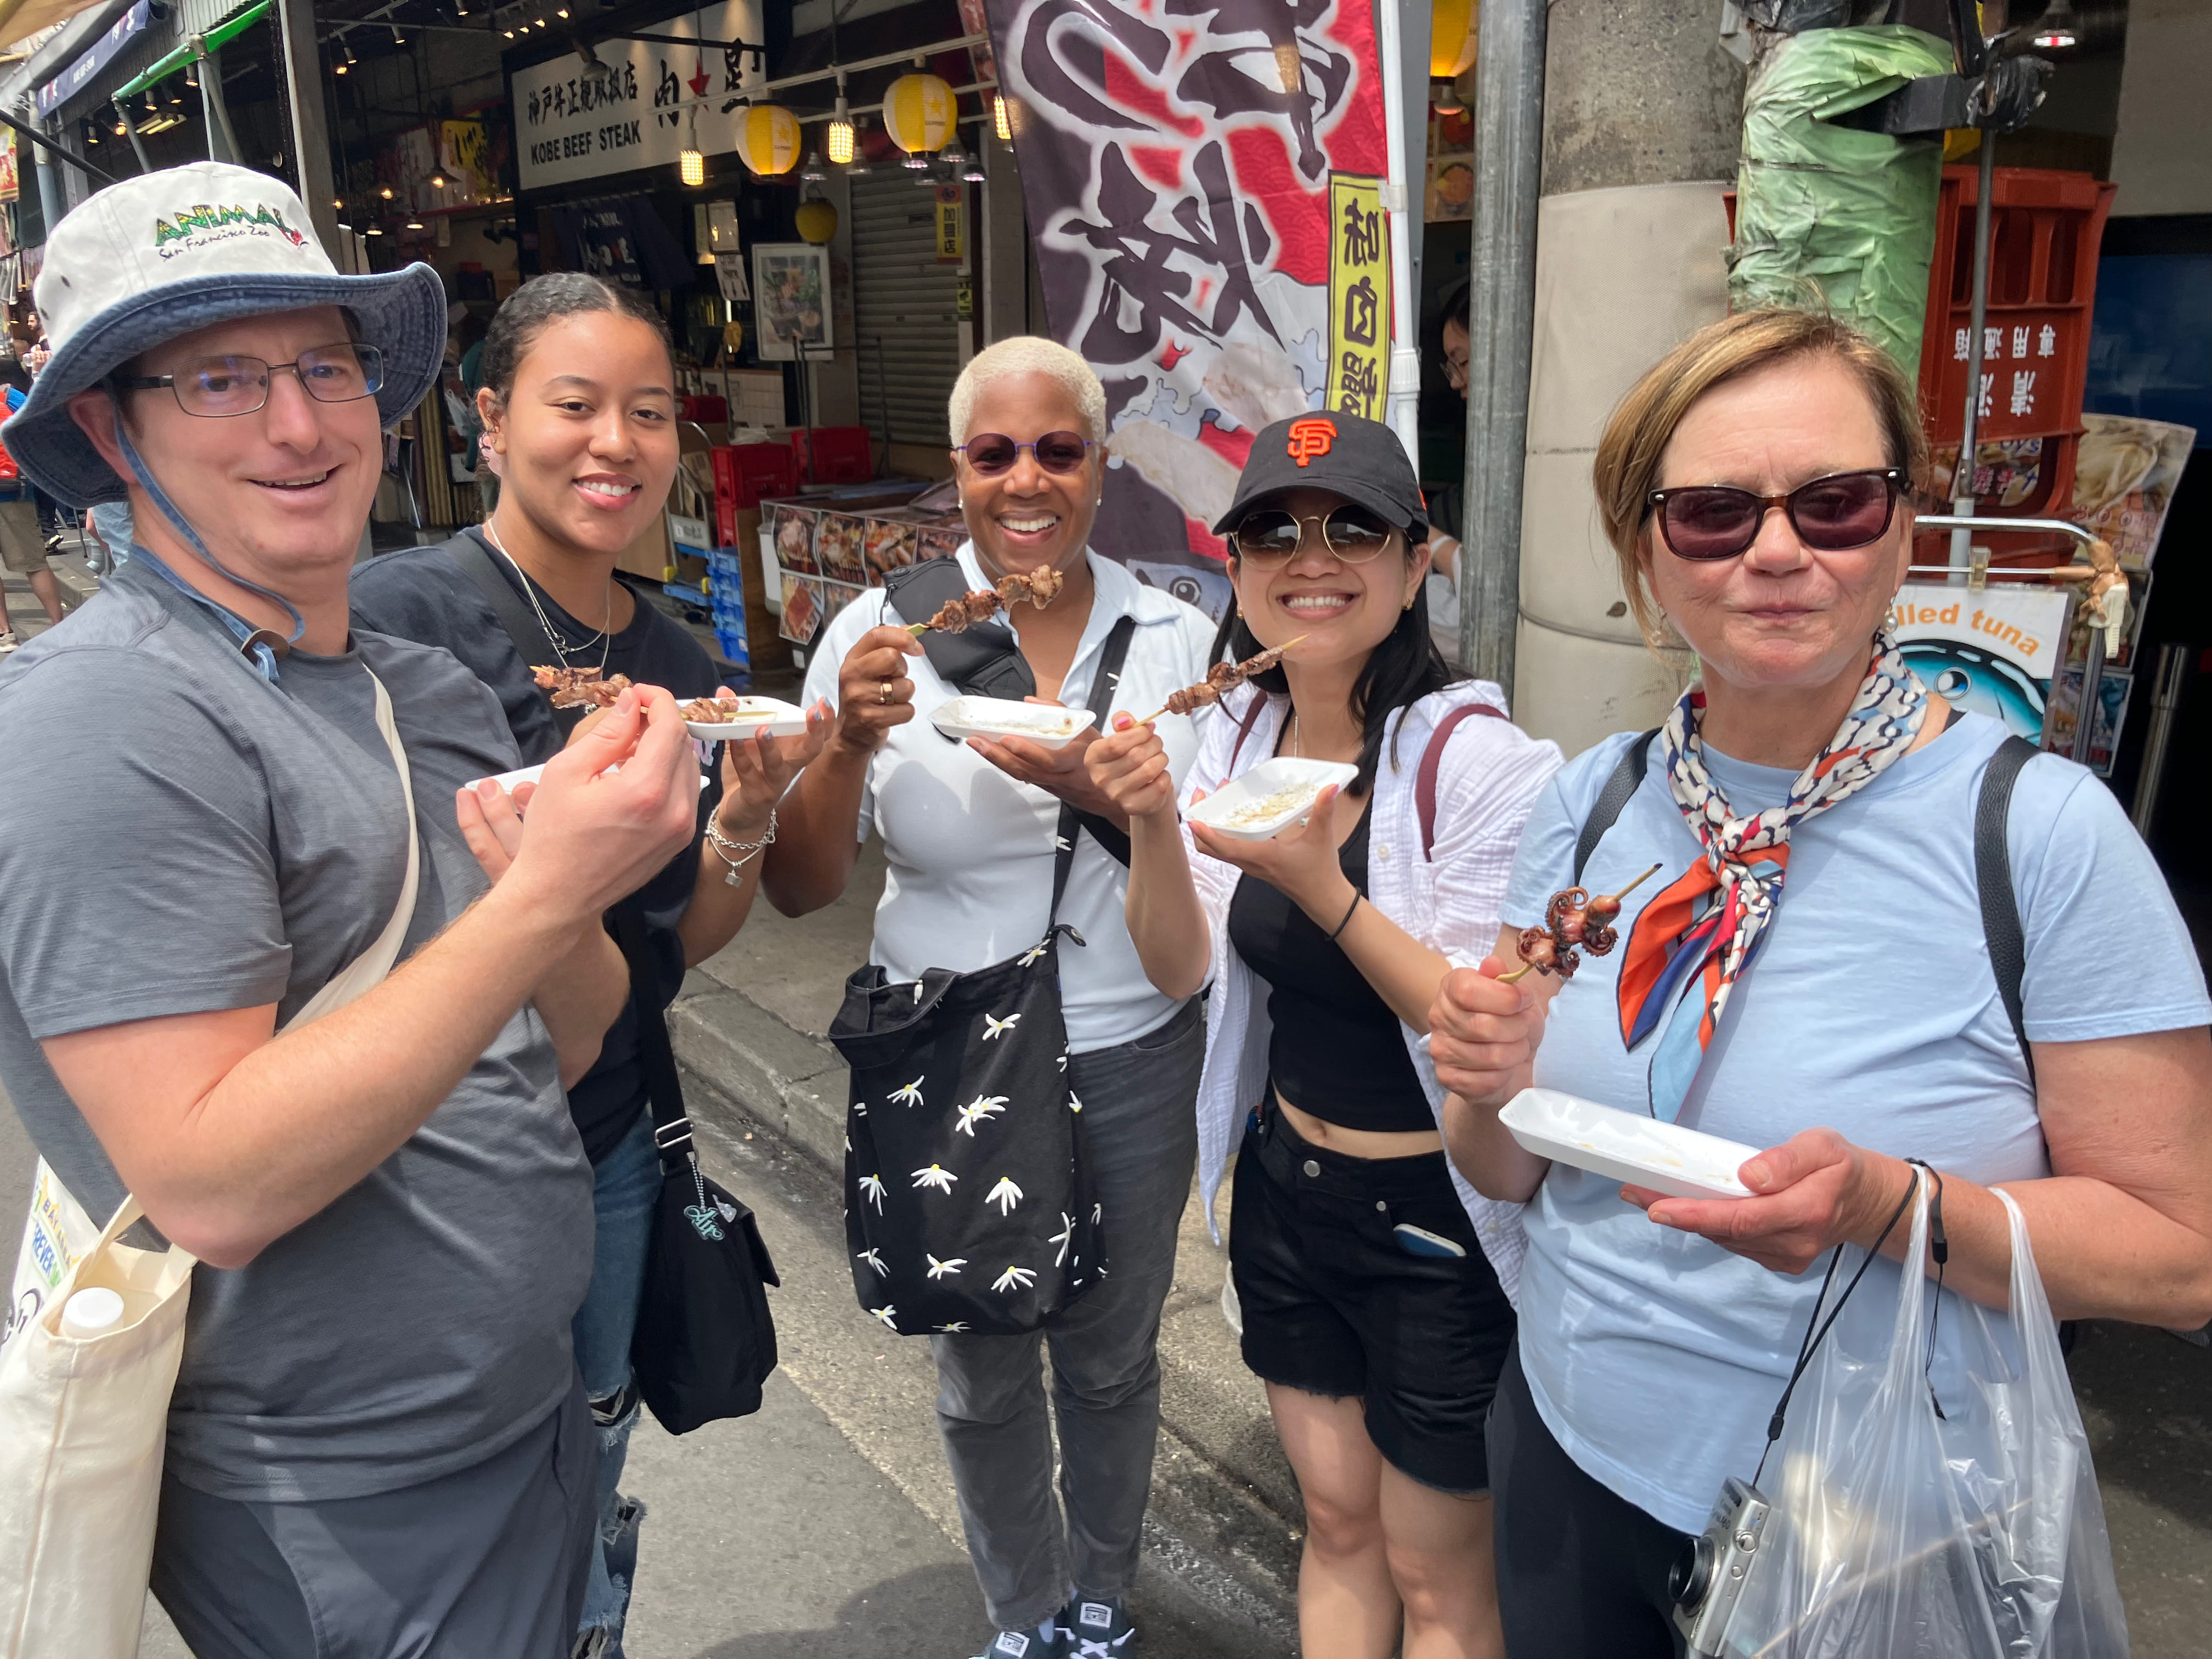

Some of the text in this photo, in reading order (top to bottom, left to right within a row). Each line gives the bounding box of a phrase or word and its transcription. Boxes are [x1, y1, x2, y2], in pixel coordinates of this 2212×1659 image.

[531, 120, 642, 166] KOBE BEEF STEAK
[186, 229, 246, 250] Francisco
[247, 225, 271, 237] Zoo
[1286, 417, 1338, 468] SF
[1971, 608, 2040, 658] tuna
[43, 1198, 71, 1267] BAY AREA
